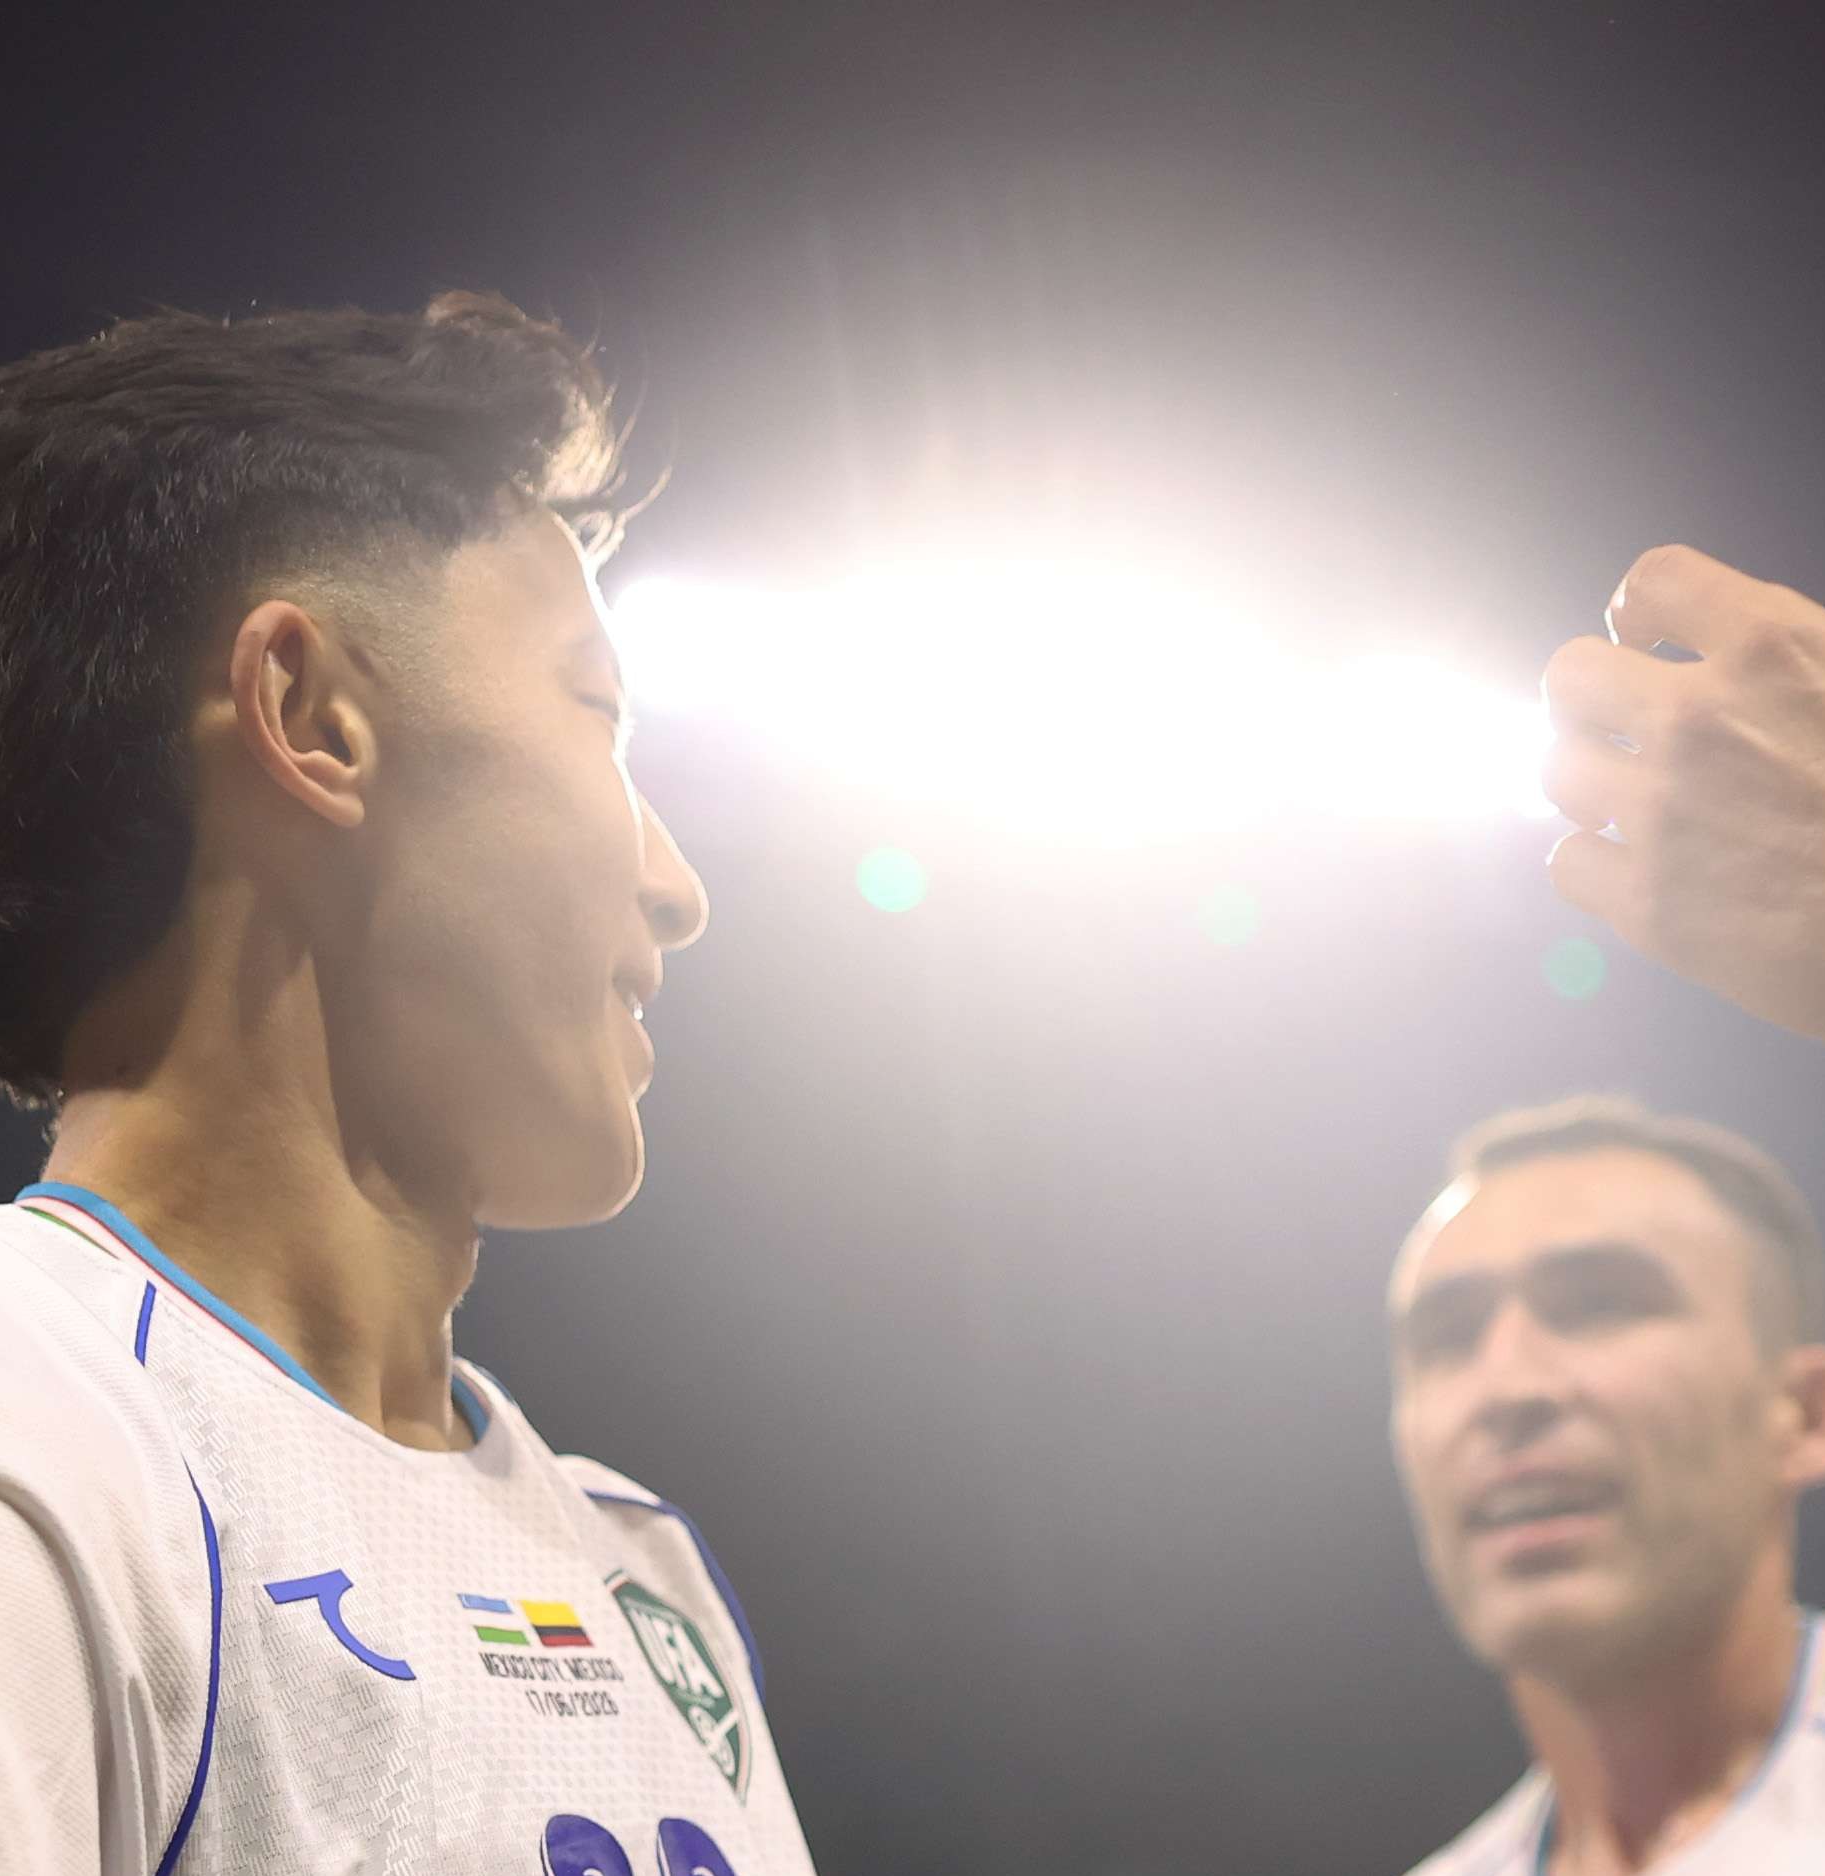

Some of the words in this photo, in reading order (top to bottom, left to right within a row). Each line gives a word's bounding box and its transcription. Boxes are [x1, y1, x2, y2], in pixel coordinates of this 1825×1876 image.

[478, 1652, 535, 1681] MEXICO
[563, 1656, 625, 1682] MEXICO
[628, 1606, 724, 1699] UFA
